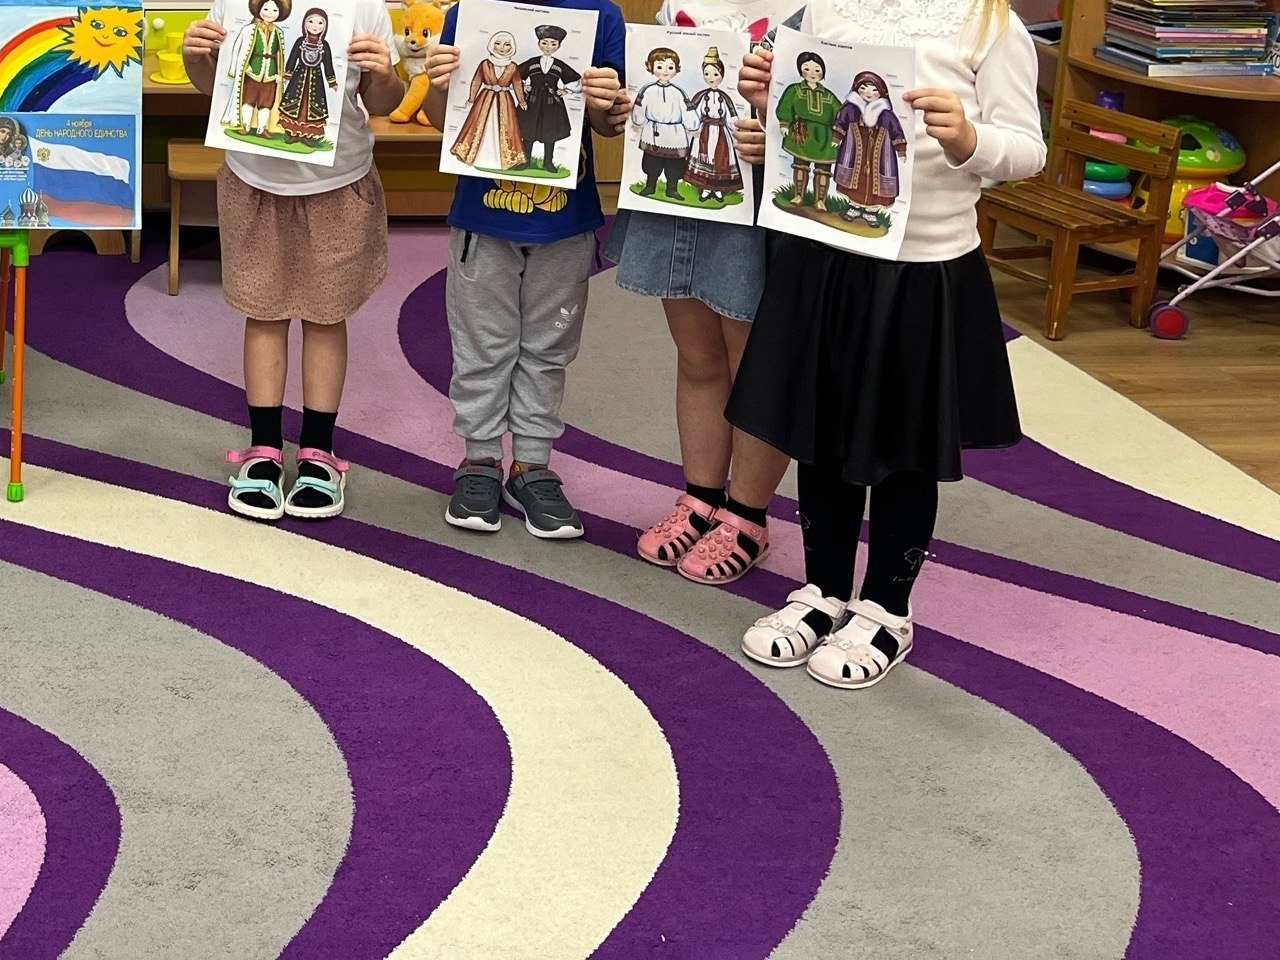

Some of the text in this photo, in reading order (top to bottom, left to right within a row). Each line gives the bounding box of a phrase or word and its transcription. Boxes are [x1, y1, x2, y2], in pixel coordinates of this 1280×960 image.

[71, 118, 92, 128] ноября
[36, 129, 128, 138] ДЕНЬ НАРОДНОГО ЕДИНСТВА
